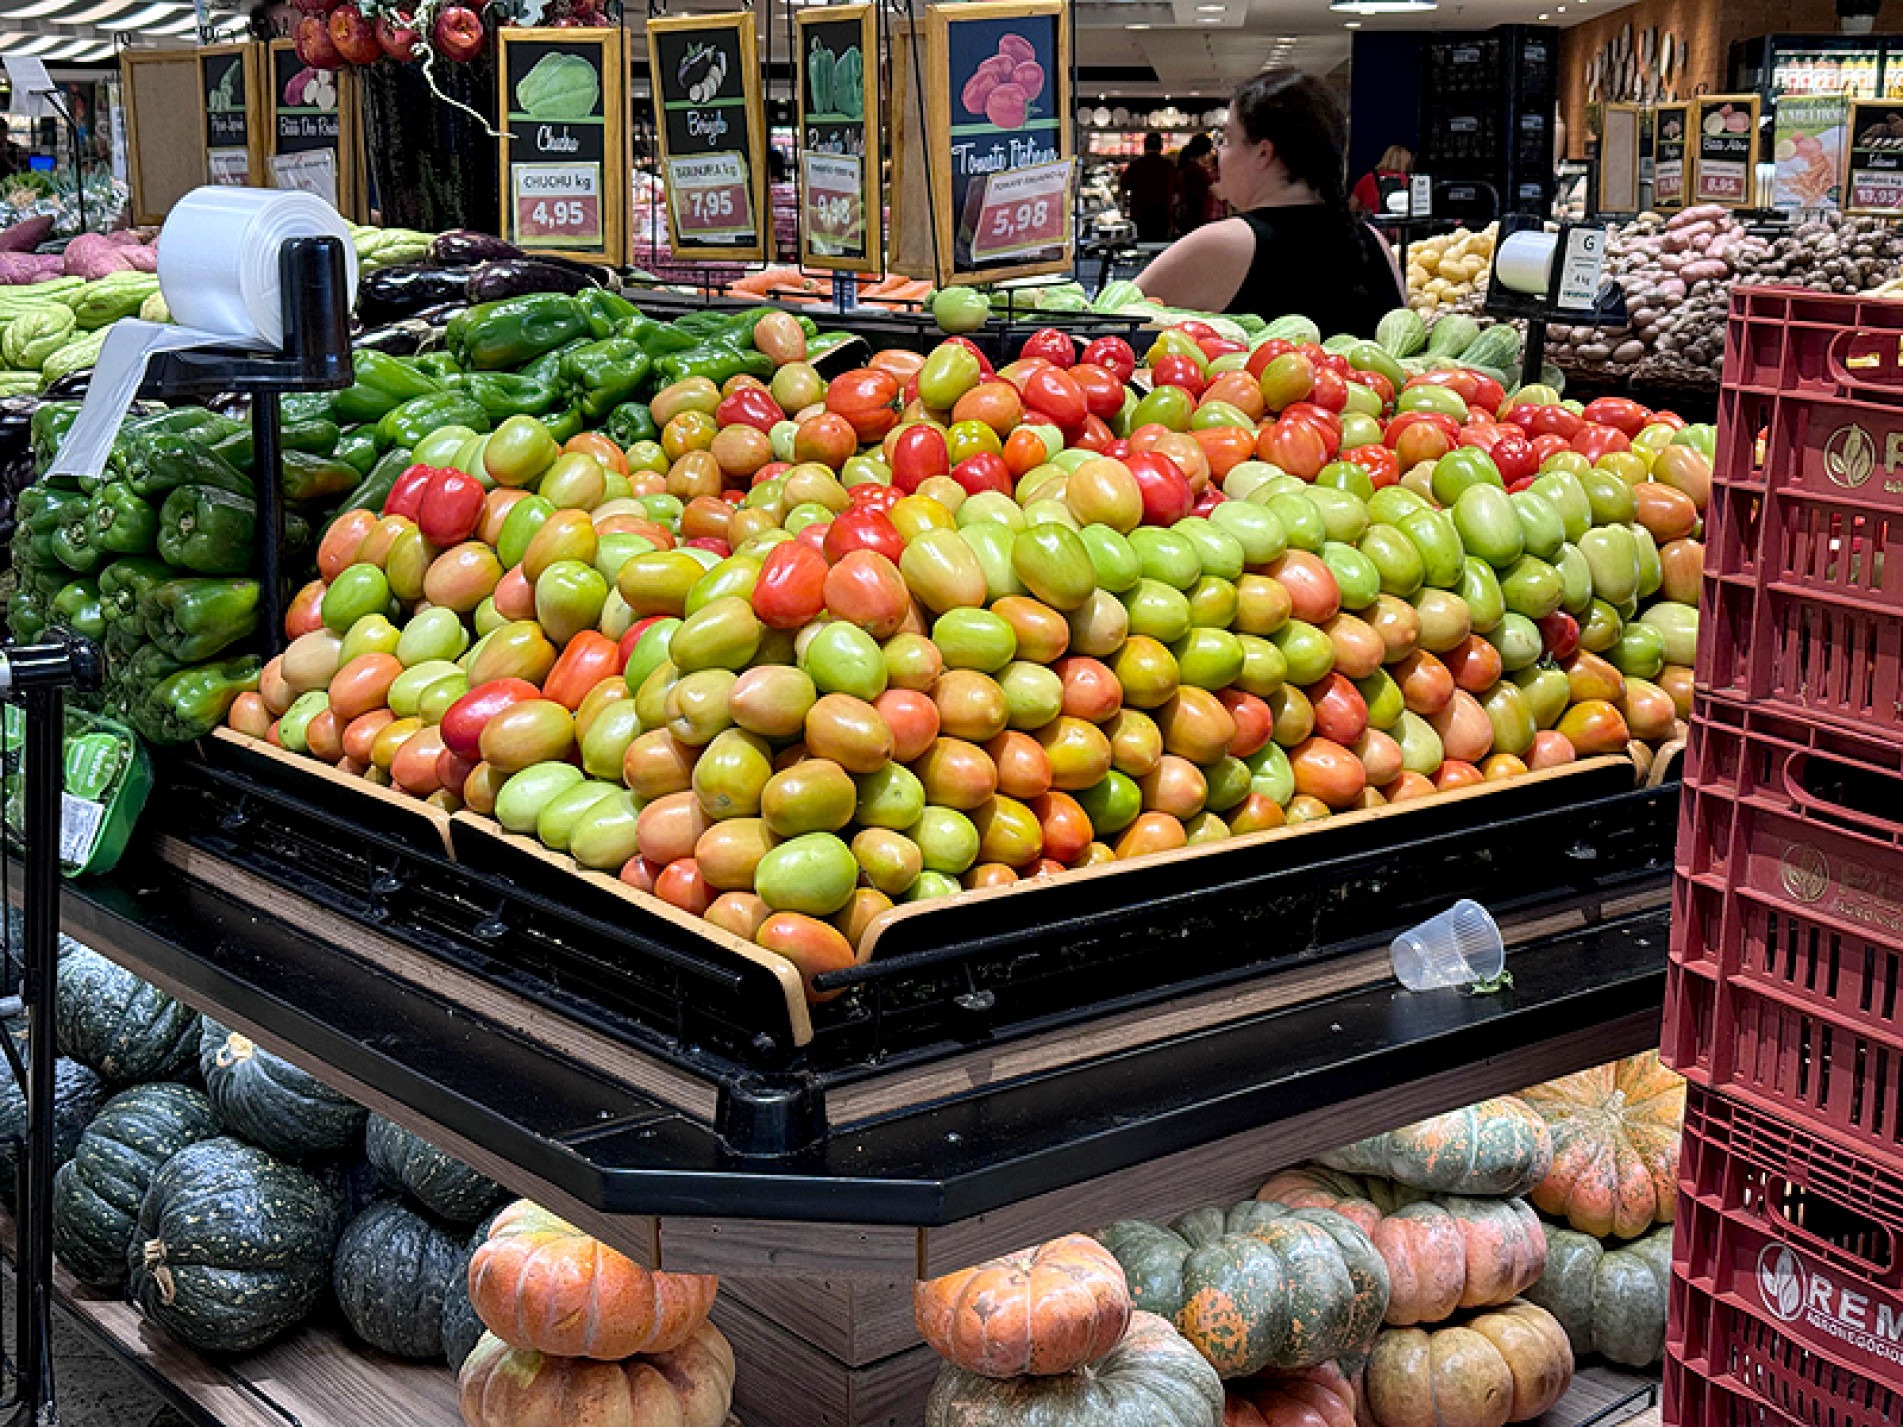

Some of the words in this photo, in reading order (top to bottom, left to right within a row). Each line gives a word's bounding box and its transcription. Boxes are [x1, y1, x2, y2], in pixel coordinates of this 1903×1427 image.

[523, 174, 572, 189] CHUCHU
[575, 173, 591, 191] kg
[532, 201, 584, 229] 4,95
[689, 189, 734, 225] 7,95
[991, 199, 1049, 238] 5,98
[1583, 234, 1595, 252] G
